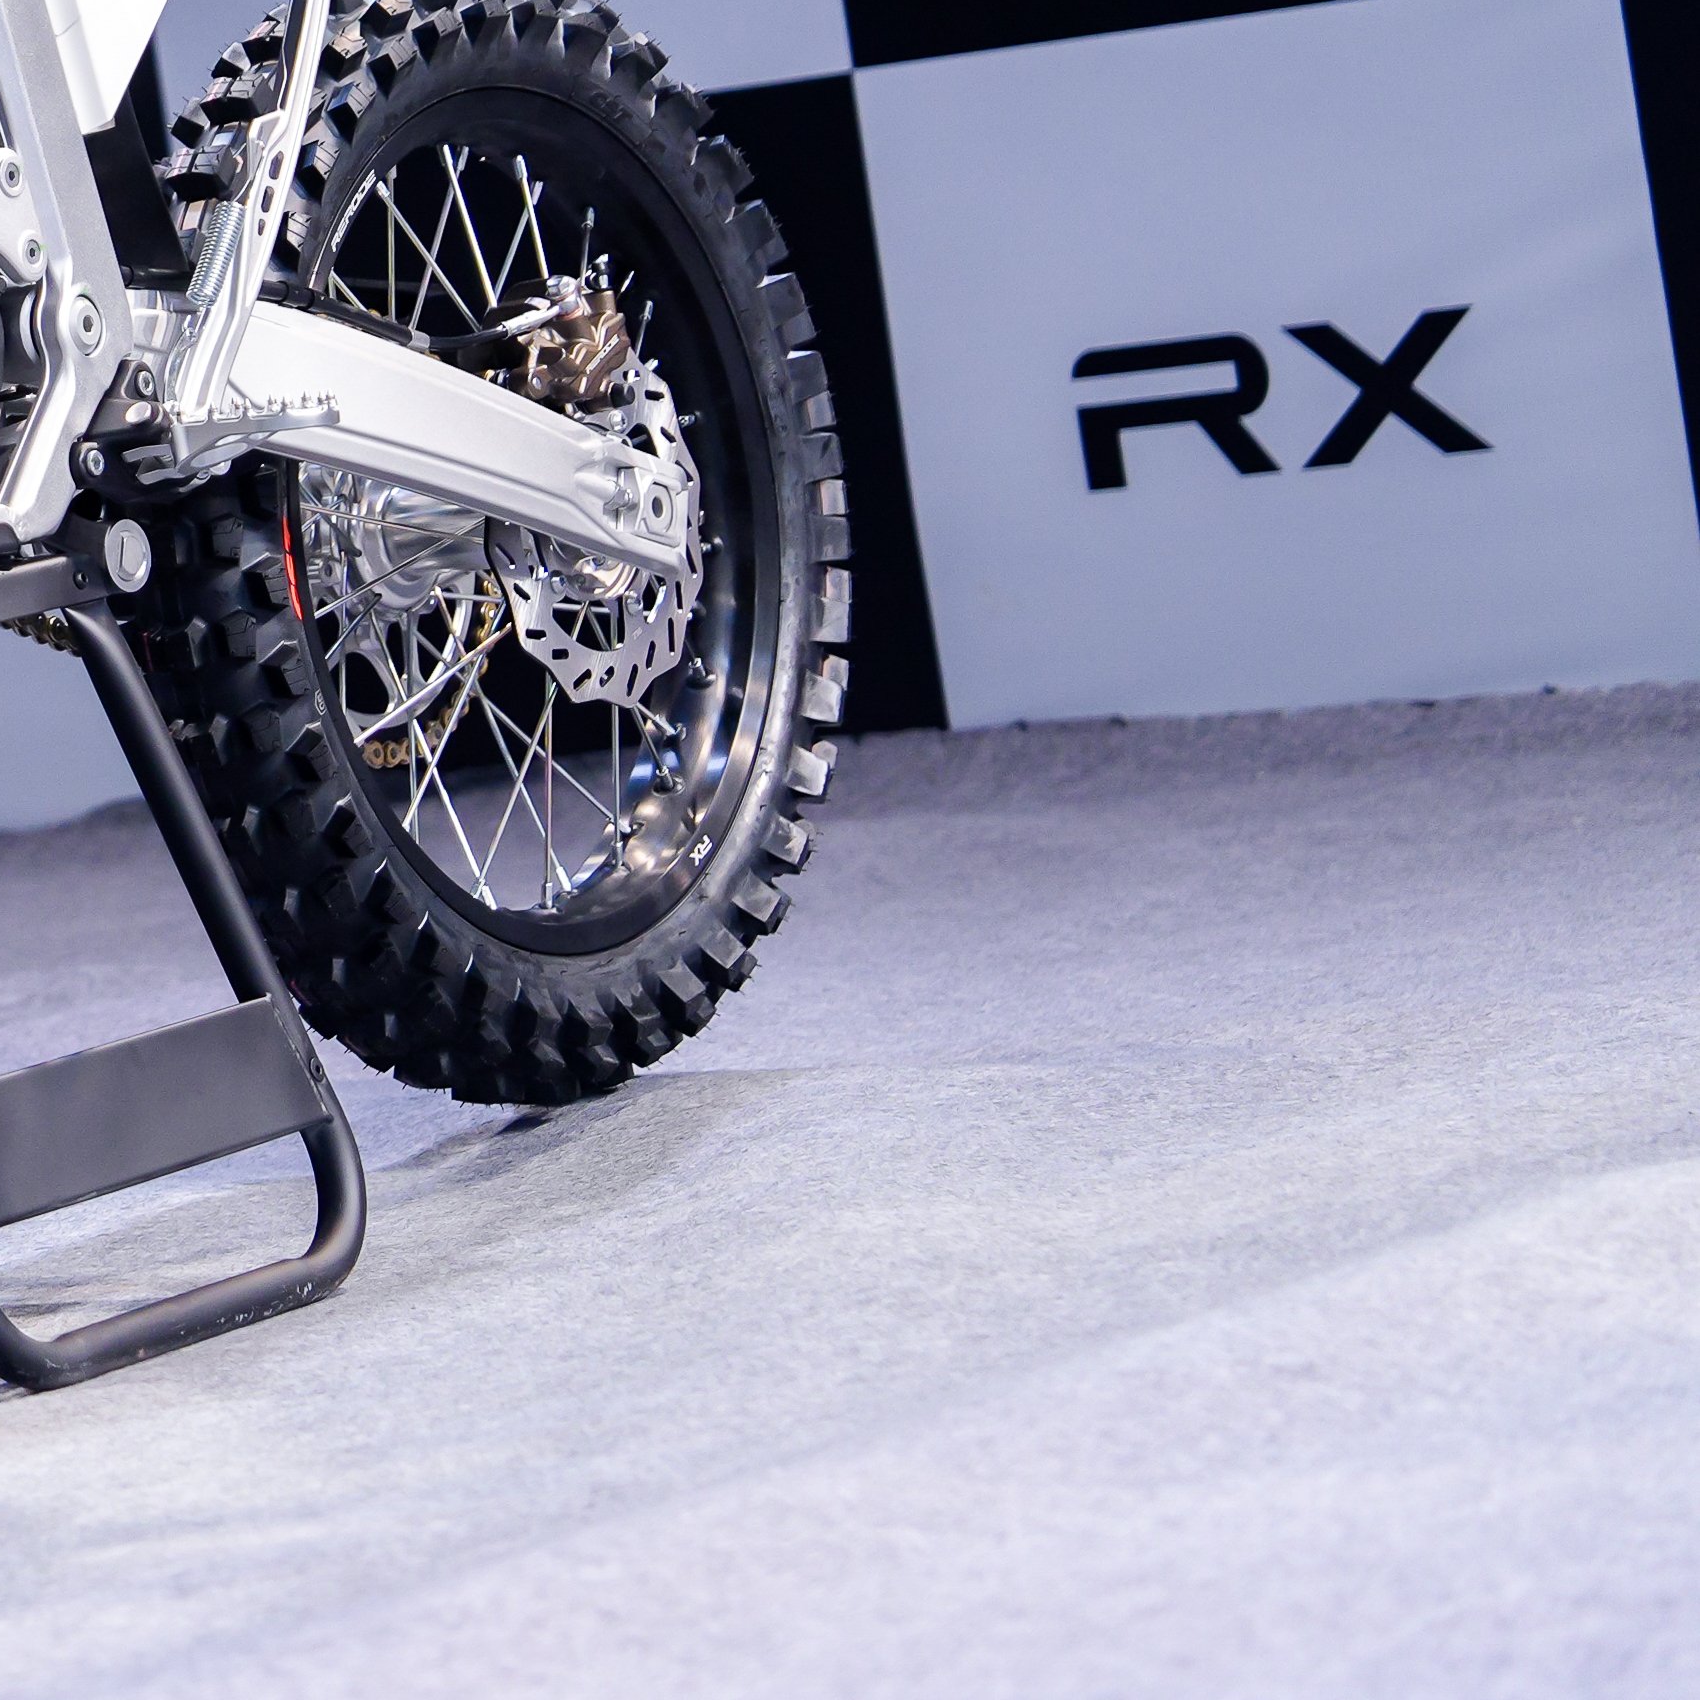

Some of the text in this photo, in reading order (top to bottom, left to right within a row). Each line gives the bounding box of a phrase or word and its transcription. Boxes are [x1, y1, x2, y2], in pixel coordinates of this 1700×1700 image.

[330, 168, 377, 253] RERODE
[1071, 305, 1492, 491] RX
[688, 834, 713, 867] RX
